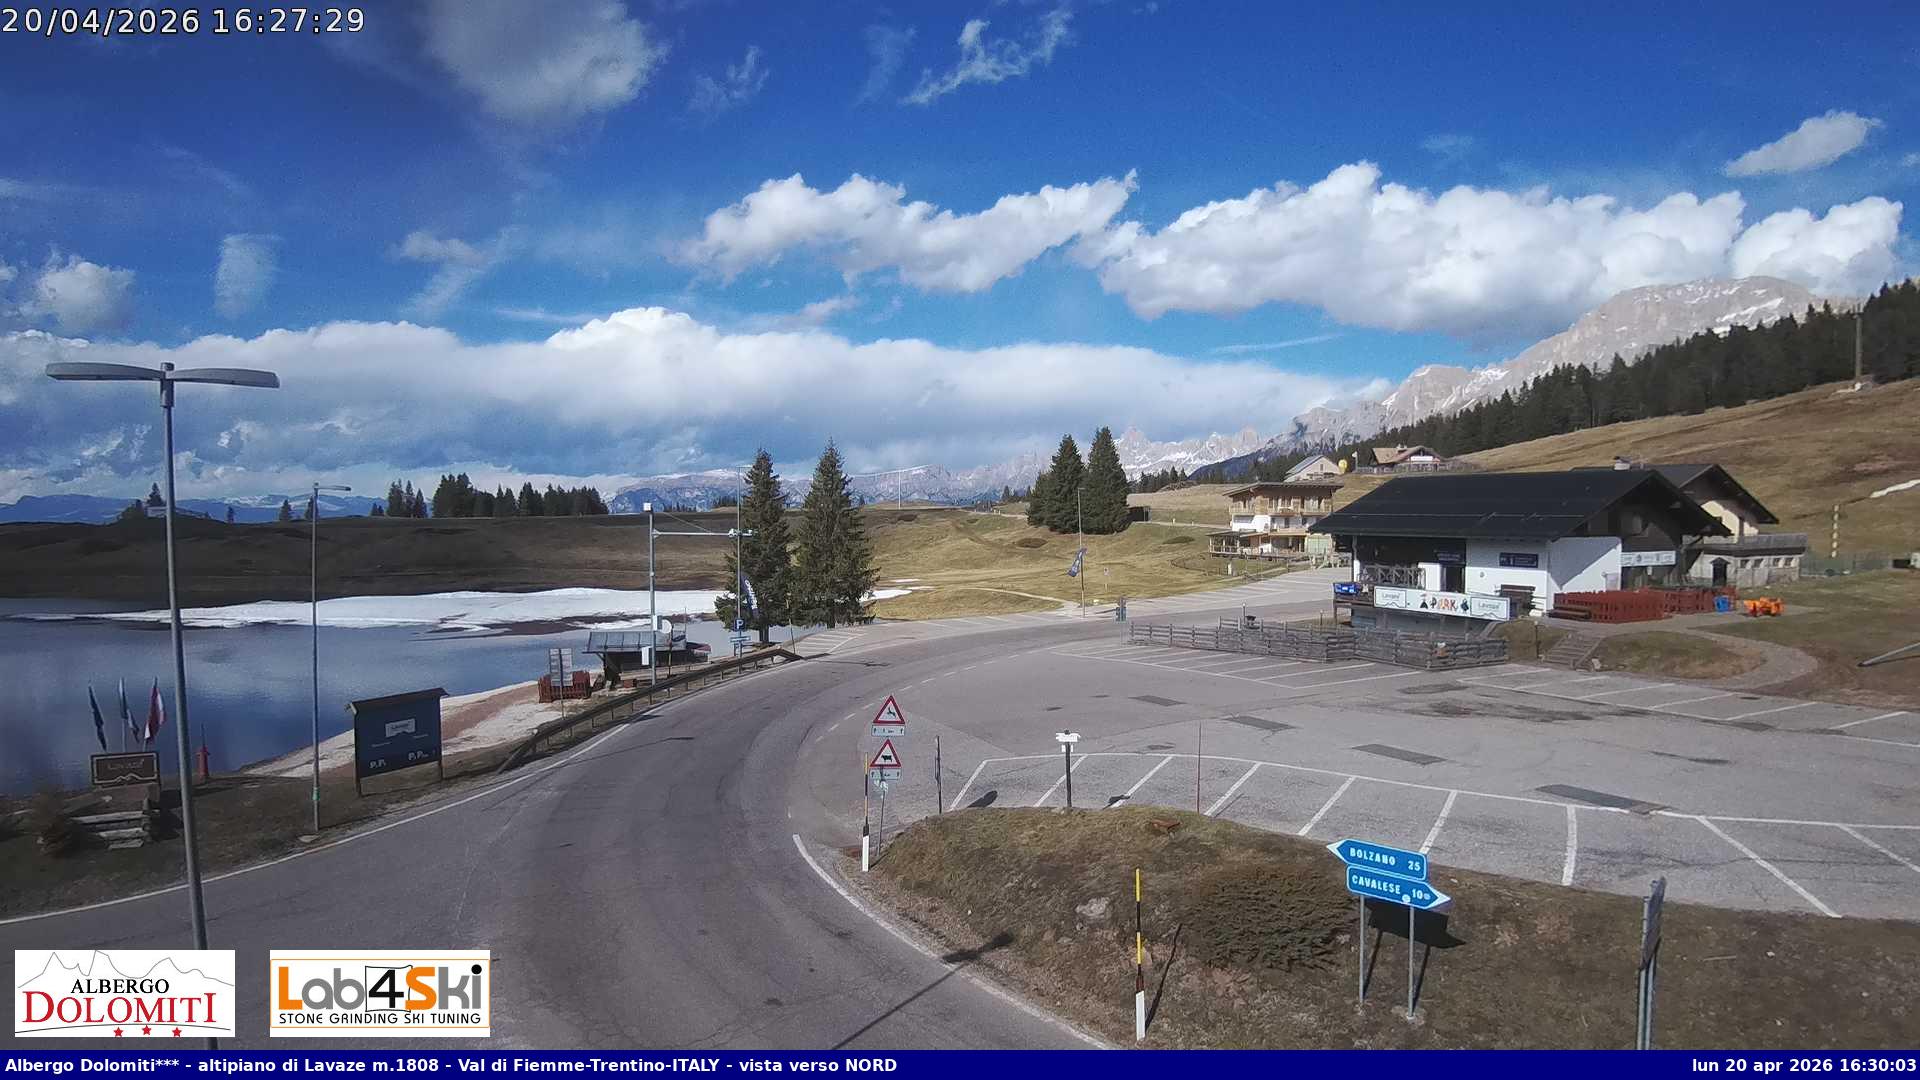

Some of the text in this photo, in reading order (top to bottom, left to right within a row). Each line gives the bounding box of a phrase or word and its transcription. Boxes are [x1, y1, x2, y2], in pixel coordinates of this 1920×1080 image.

[1349, 847, 1421, 872] BOLZANO 25
[1351, 874, 1401, 894] CAVALESE
[1411, 888, 1423, 900] 10
